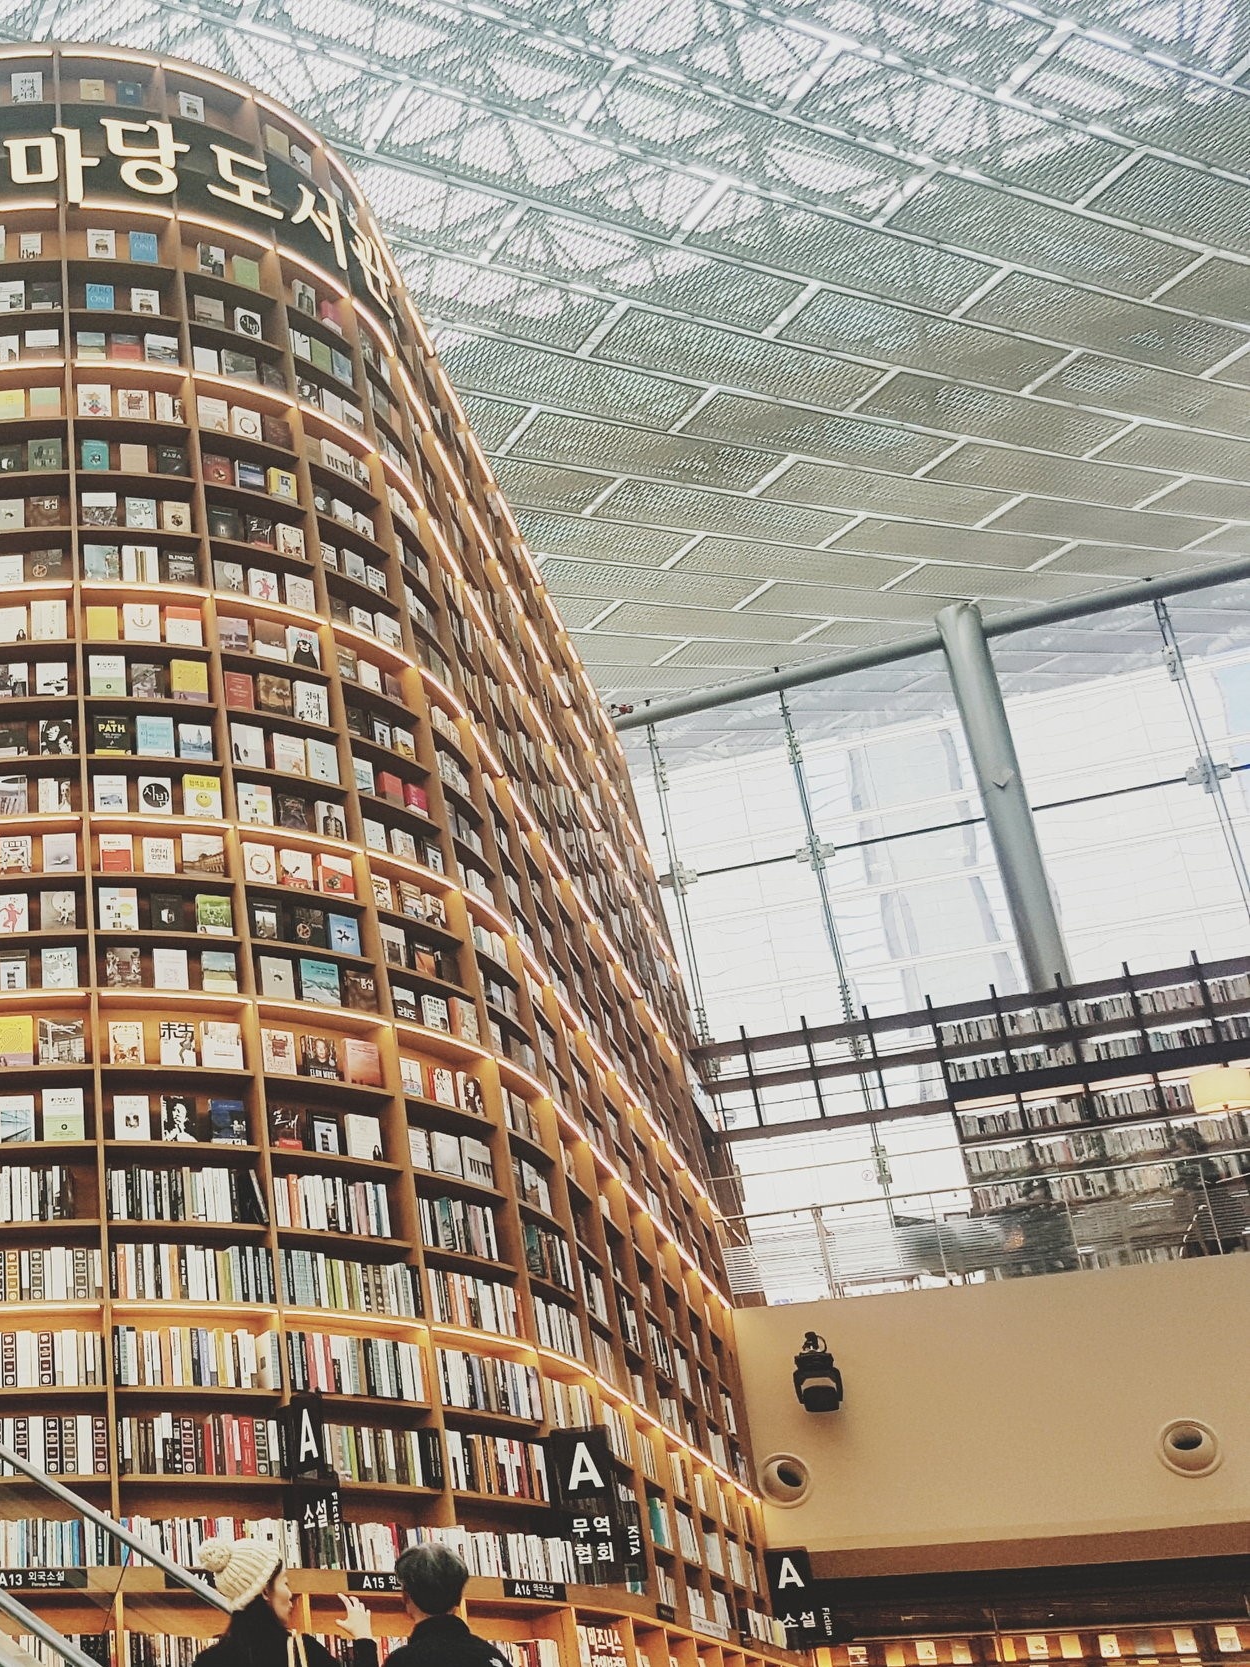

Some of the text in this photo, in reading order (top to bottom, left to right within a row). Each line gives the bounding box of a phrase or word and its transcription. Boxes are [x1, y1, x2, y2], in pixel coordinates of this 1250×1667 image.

[97, 723, 126, 733] PATH
[300, 1408, 319, 1463] A
[568, 1441, 605, 1491] A
[303, 1499, 328, 1530] 소설
[331, 1491, 341, 1541] Fiction
[572, 1516, 611, 1539] 무역
[574, 1541, 615, 1565] 협회
[627, 1525, 641, 1556] KITA
[28, 1571, 65, 1581] 외국소설
[362, 1575, 385, 1589] A15
[778, 1557, 805, 1589] A
[514, 1582, 531, 1596] A16
[782, 1611, 816, 1628] 소설
[822, 1607, 833, 1636] Fiction
[587, 1626, 624, 1654] 비즈니스
